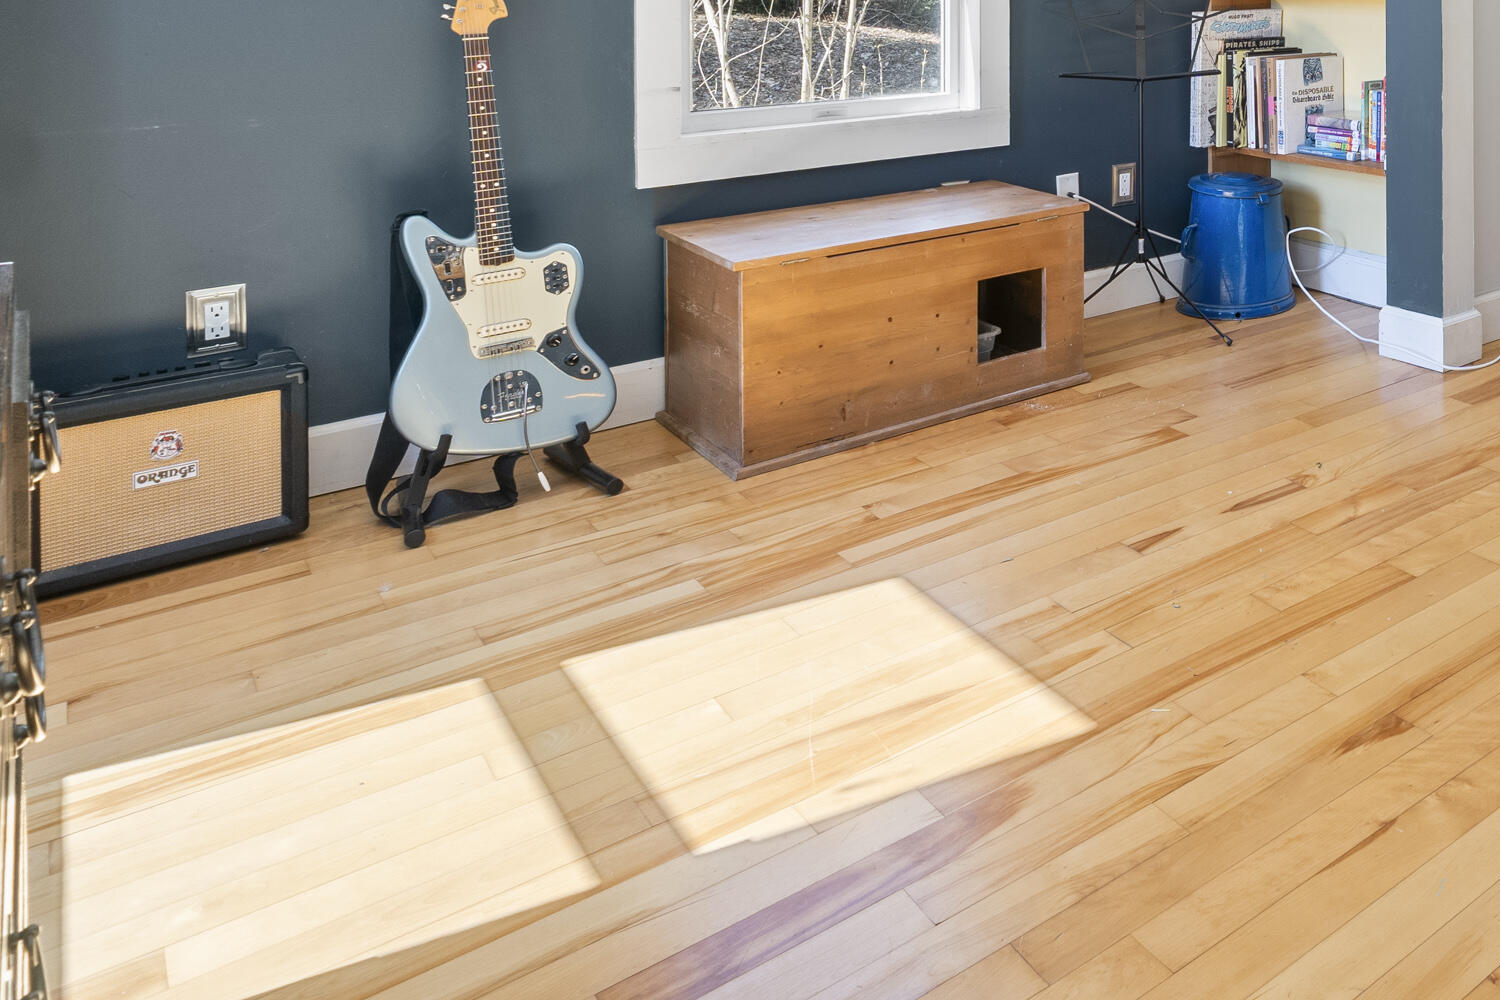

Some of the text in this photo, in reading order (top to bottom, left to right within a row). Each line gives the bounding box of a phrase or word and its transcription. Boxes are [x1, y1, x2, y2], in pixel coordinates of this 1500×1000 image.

[1259, 39, 1280, 48] SHIPS
[1298, 86, 1334, 96] DISPOSABLE
[136, 464, 196, 484] ORANGE
